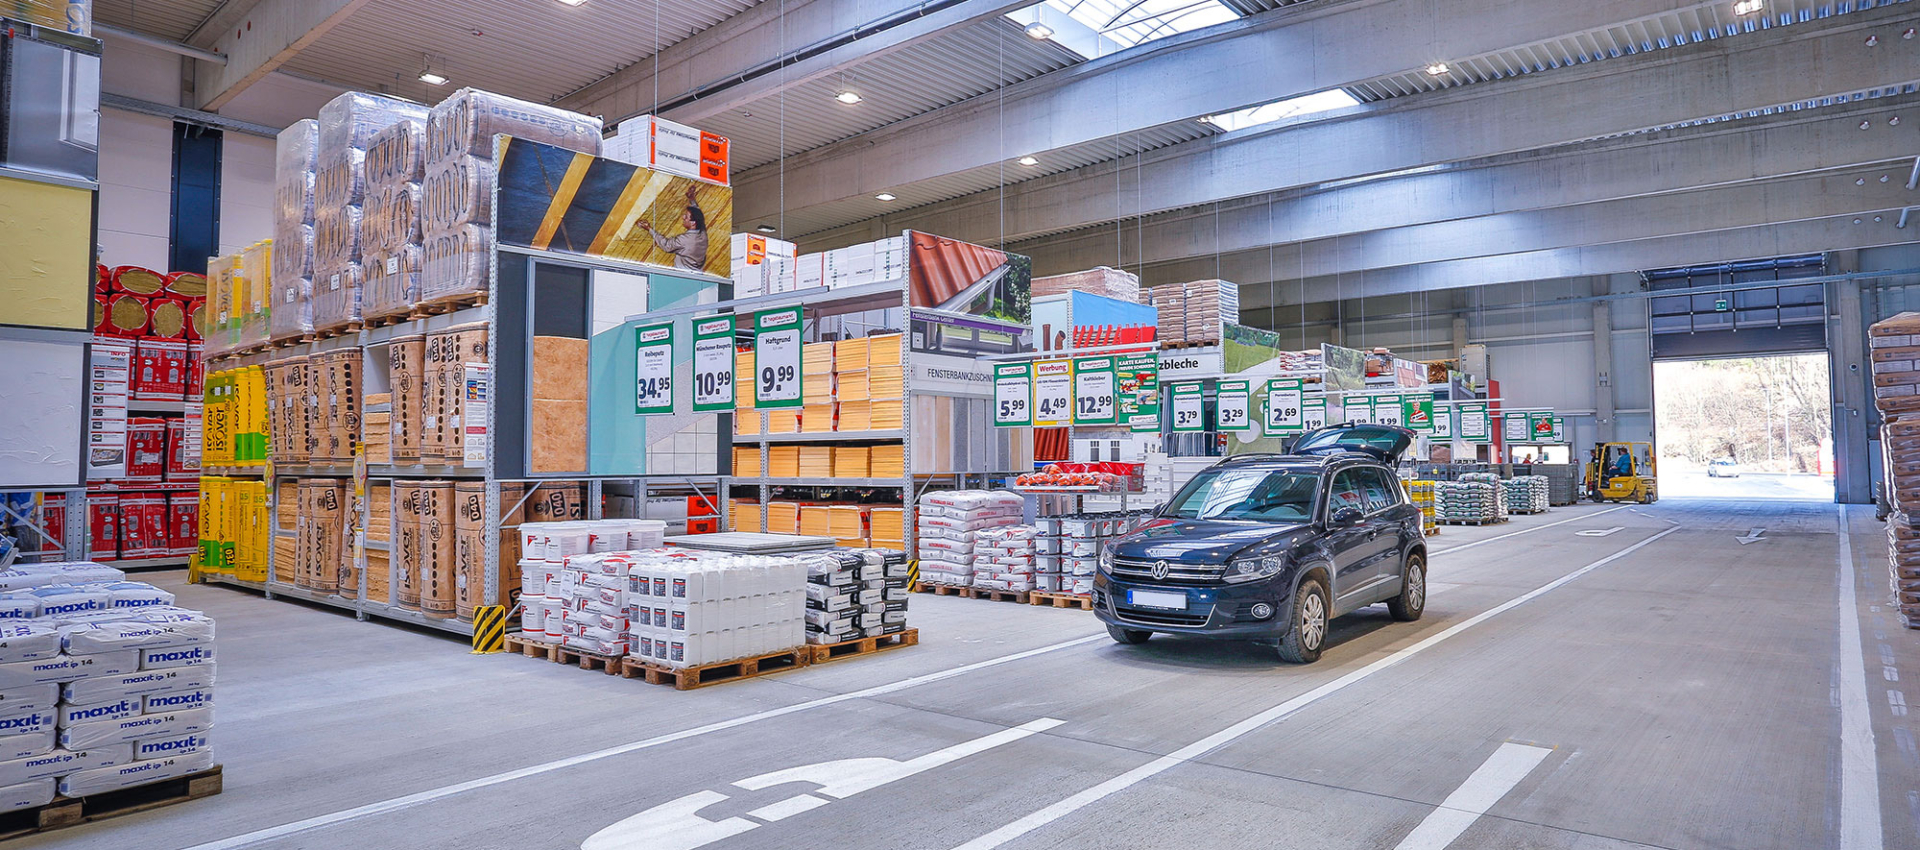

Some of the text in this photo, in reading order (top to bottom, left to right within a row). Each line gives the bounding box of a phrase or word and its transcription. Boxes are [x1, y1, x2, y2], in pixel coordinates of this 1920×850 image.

[765, 336, 791, 346] Haftgrund
[1038, 363, 1067, 373] Werbung
[1159, 357, 1199, 371] zbleche
[294, 366, 302, 386] 040
[696, 370, 731, 397] 10.99
[762, 365, 794, 393] 9.99
[330, 367, 338, 422] isoer
[638, 377, 670, 400] 34.95
[312, 370, 320, 424] isoer
[1078, 396, 1112, 413] 12.99
[1000, 399, 1025, 417] 5.99
[1040, 397, 1067, 415] 4.49
[1177, 410, 1198, 424] 3.79
[1222, 408, 1244, 423] 3.29
[1274, 407, 1297, 422] 2.69
[326, 490, 337, 510] 040
[469, 496, 480, 520] 040
[551, 493, 565, 516] 040
[225, 548, 235, 566] 032
[45, 598, 97, 615] maxit
[115, 597, 162, 607] maxit
[120, 629, 152, 638] maxit
[148, 647, 202, 663] maxit
[34, 661, 69, 671] maxit
[122, 674, 154, 685] maxit
[150, 691, 203, 707] maxit
[70, 700, 129, 721] maxit
[0, 714, 41, 730] axit
[120, 718, 152, 729] maxit
[142, 736, 197, 753] maxit
[26, 755, 62, 767] maxit
[120, 763, 152, 775] maxit
